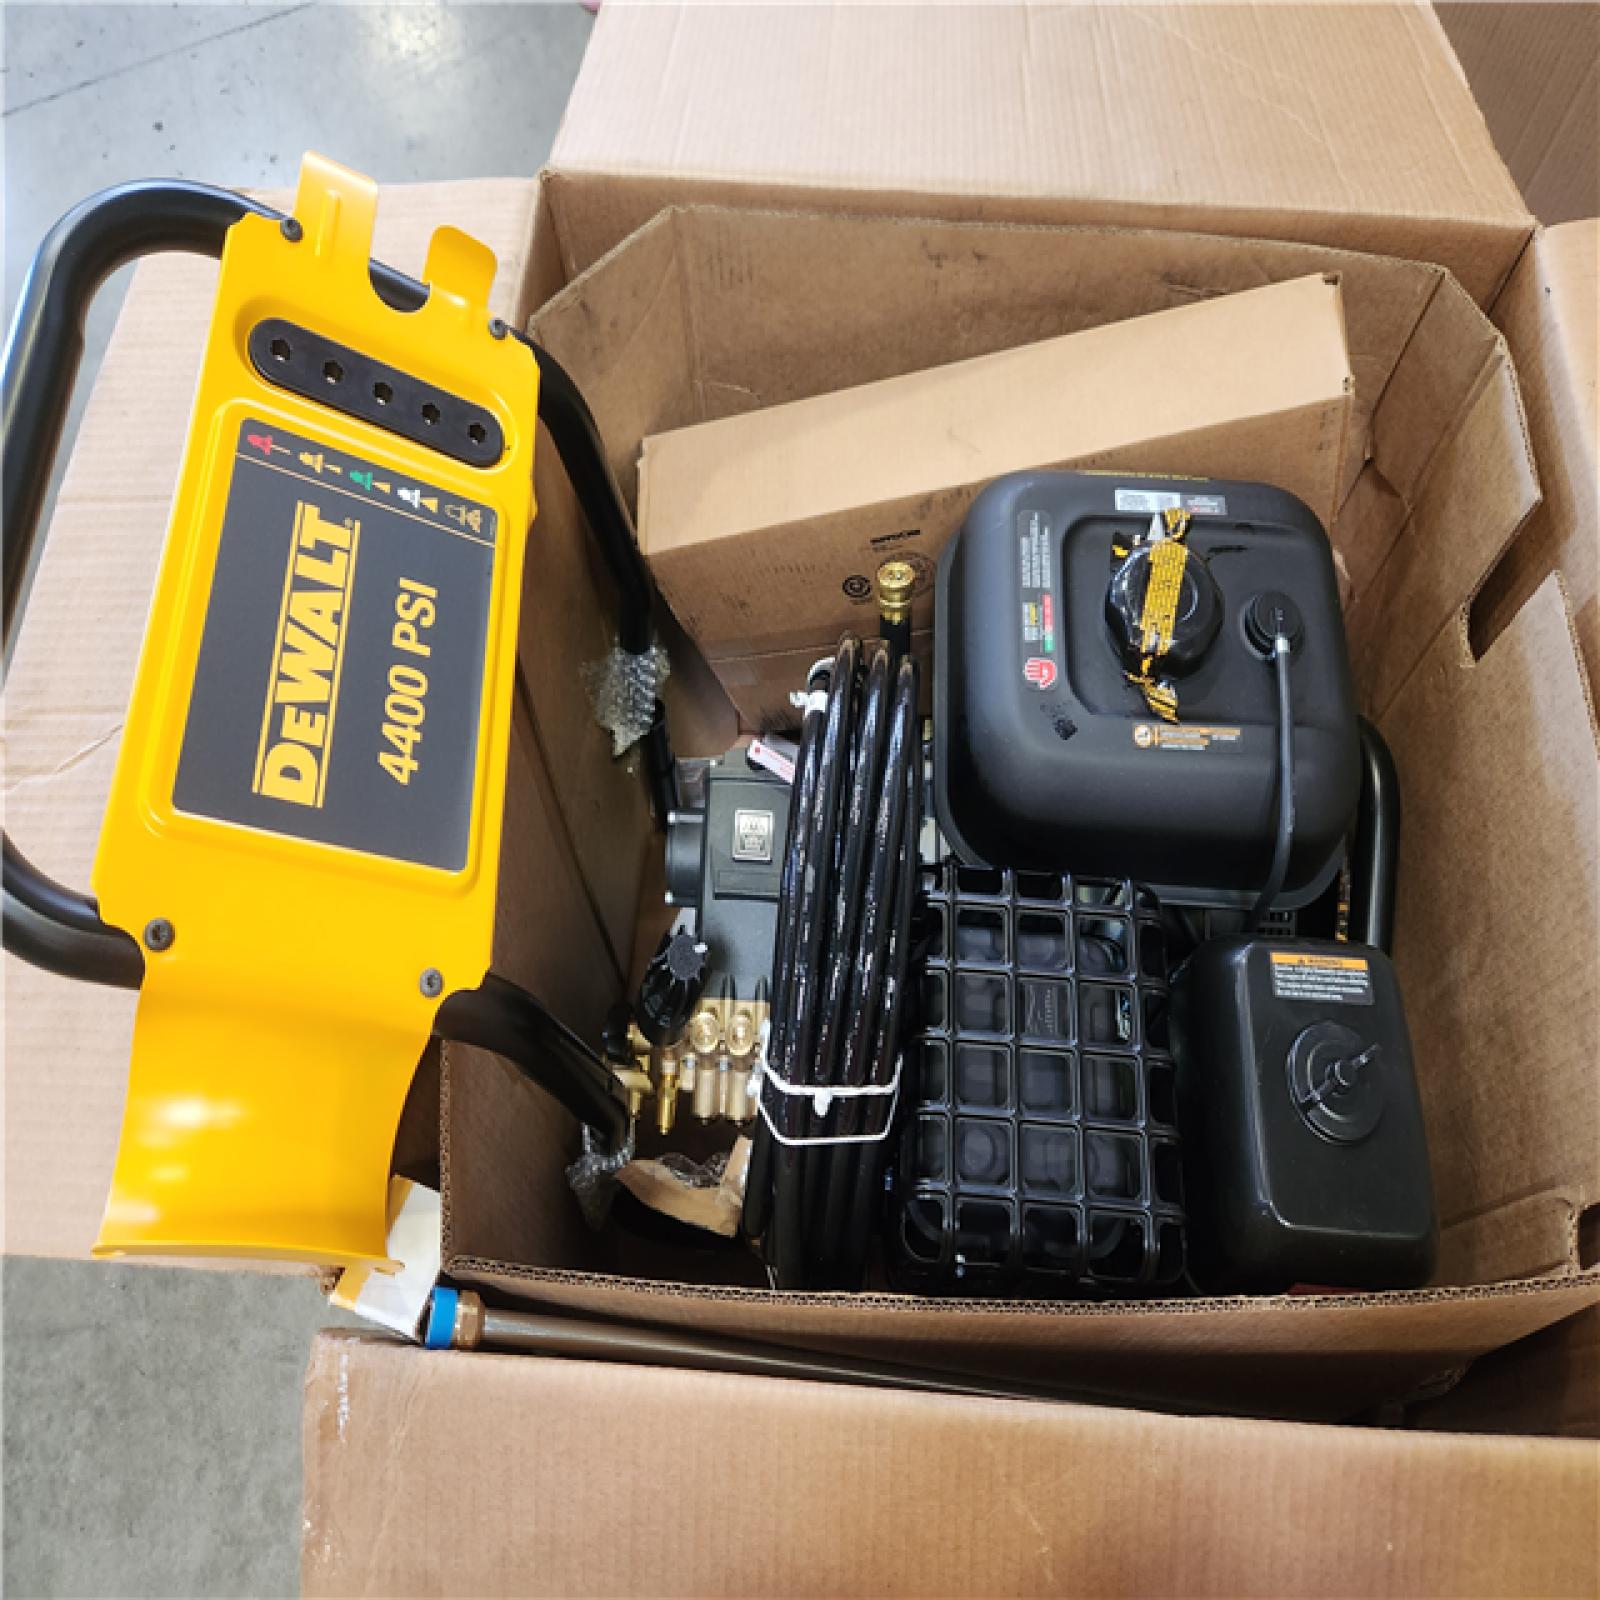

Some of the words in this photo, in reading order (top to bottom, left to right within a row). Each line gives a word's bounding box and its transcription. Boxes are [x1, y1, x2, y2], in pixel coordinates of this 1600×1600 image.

[260, 503, 353, 807] DEWALT
[391, 576, 439, 658] PSI
[377, 664, 429, 786] 4400
